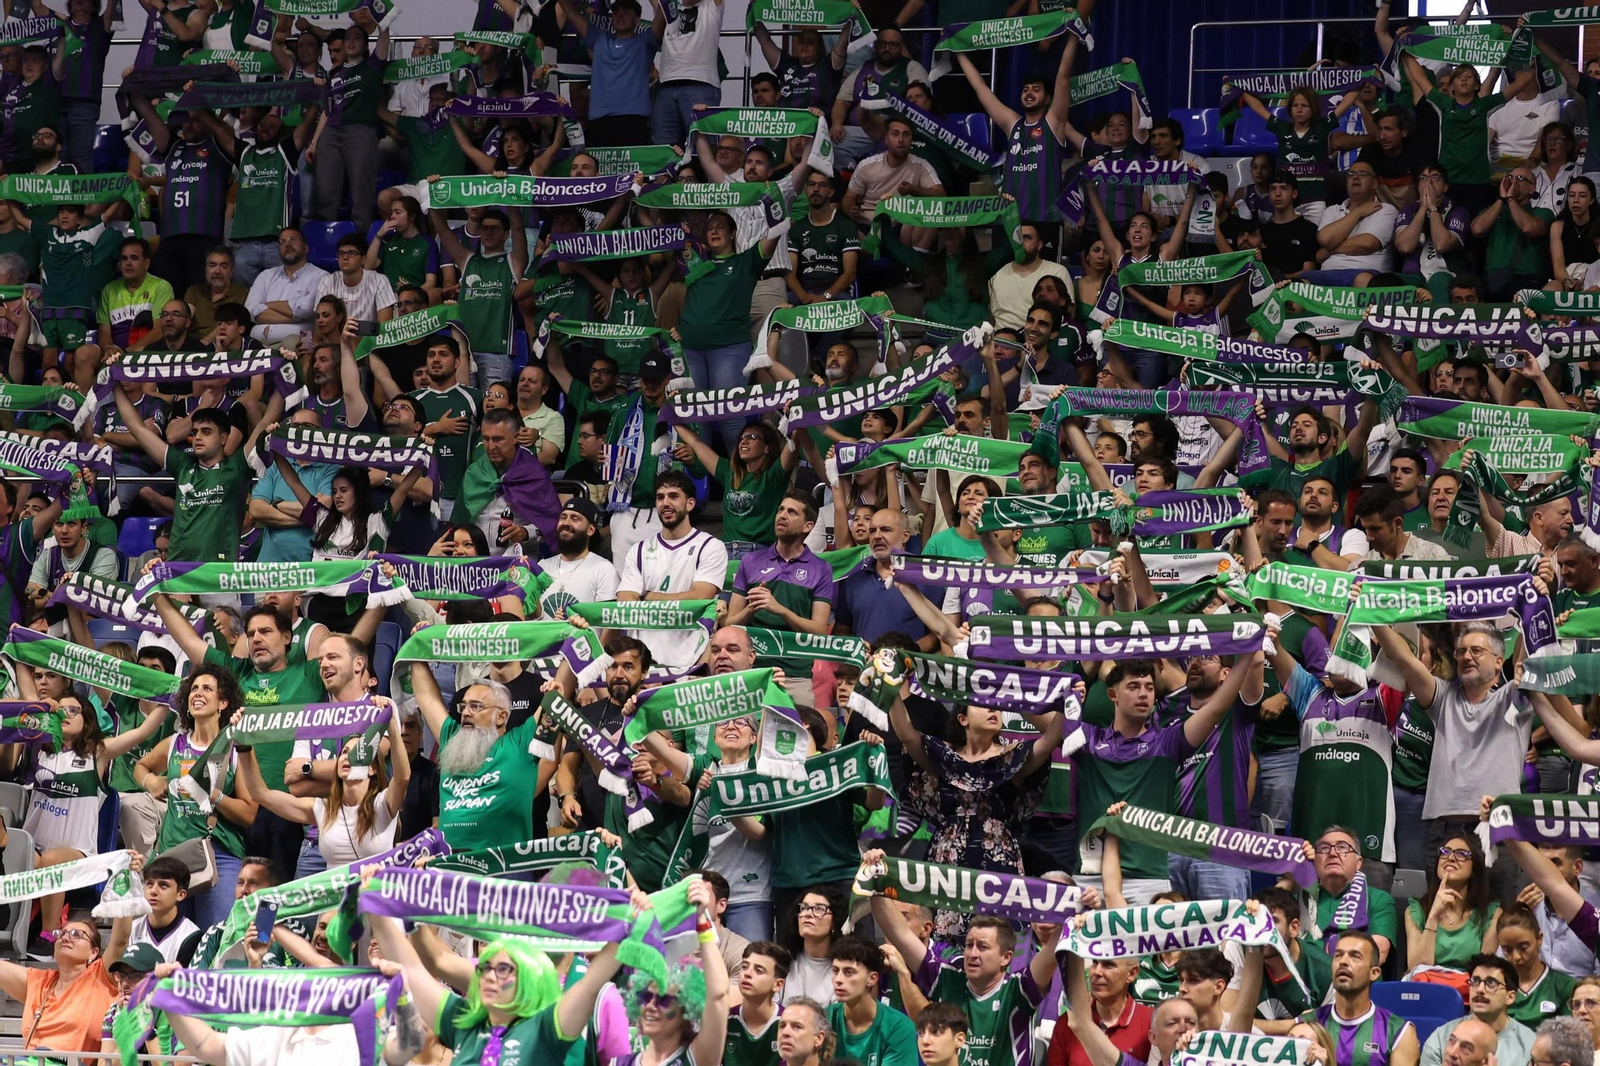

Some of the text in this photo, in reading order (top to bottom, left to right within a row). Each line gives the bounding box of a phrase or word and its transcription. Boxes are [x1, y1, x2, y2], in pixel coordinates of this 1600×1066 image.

[280, 1, 339, 13] BALONCESTO
[773, 0, 815, 10] UNICAJA
[762, 8, 824, 23] BALONCESTO
[0, 18, 57, 42] BALONCESTO
[982, 19, 1023, 33] UNICAJA
[1435, 24, 1480, 35] UNICAJA
[464, 31, 522, 45] BALONCESTO
[972, 29, 1033, 46] BALONCESTO
[1456, 38, 1504, 51] UNICAJA
[211, 50, 254, 61] UNICAJA
[406, 55, 442, 66] UNICAJA
[398, 61, 451, 78] BALONCESTO
[1078, 66, 1113, 84] UNICAJA
[1233, 70, 1361, 94] UNICAJA BALONCESTO
[739, 110, 786, 121] UNICAJA
[727, 121, 795, 134] BALONCESTO
[907, 105, 989, 165] TIENE UN PLAN!
[590, 151, 630, 161] UNICAJA
[171, 174, 199, 183] málaga
[256, 168, 278, 176] Unicaja
[16, 177, 70, 193] UNICAJA
[461, 179, 607, 197] Unicaja Baloncesto
[684, 183, 730, 192] UNICAJA
[174, 191, 189, 207] 51
[673, 192, 740, 206] BALONCESTO
[885, 197, 944, 215] UNICAJA
[556, 224, 684, 256] UNICAJA BALONCESTO
[815, 253, 838, 262] Unicaja
[1145, 267, 1217, 281] BALONCESTO
[480, 280, 502, 289] Unicaja
[1290, 283, 1355, 307] UNICAJA
[623, 310, 635, 325] 11
[808, 300, 859, 318] UNICAJA
[1332, 306, 1344, 314] COPA
[384, 310, 428, 330] UNICAJA
[1368, 305, 1521, 335] UNICAJA
[376, 314, 440, 345] BALONCESTO
[1315, 326, 1340, 335] Unicaja
[1133, 321, 1304, 365] Unicaja Baloncesto
[123, 349, 271, 378] UNICAJA
[1218, 364, 1243, 380] Unicaja
[1264, 363, 1335, 376] Unicaja
[818, 345, 952, 421] UNICAJA
[675, 379, 800, 419] UNICAJA
[1068, 388, 1255, 422] BALONCESTO MALAGA
[1472, 408, 1530, 425] UNICAJA
[1458, 421, 1542, 437] BALONCESTO
[286, 427, 433, 469] UNICAJA
[922, 436, 979, 457] UNICAJA
[1179, 437, 1209, 447] Unicaja
[1490, 437, 1552, 452] UNICAJA
[908, 449, 989, 473] BALONCESTO
[1486, 453, 1564, 469] ALONCESTO
[194, 484, 224, 498] Unicaja
[1162, 494, 1233, 523] UNICAJA
[220, 569, 316, 590] BALONCESTO
[434, 565, 500, 595] BALONCESTO
[1148, 568, 1179, 579] Unicaja
[1256, 564, 1329, 594] Unicaja
[660, 576, 670, 592] 4
[1355, 588, 1414, 613] nicaja
[601, 607, 694, 629] BALONCESTO
[446, 625, 508, 638] UNICAJA
[1012, 618, 1212, 651] UNICAJA
[432, 638, 520, 656] BALONCESTO
[65, 644, 121, 671] UNICAJA
[48, 654, 131, 692] BALONCESTO
[674, 677, 748, 707] UNICAJA
[662, 689, 764, 727] BALONCESTO
[285, 705, 384, 734] BALONCESTO
[551, 696, 618, 765] UNICAJA
[1336, 729, 1369, 741] Unicaja
[1402, 722, 1432, 742] Unicaja
[1315, 748, 1360, 762] málaga
[51, 780, 79, 794] Unicaja
[442, 771, 501, 789] UNIONES
[717, 755, 858, 806] Unicaja
[34, 800, 68, 817] málaga
[444, 795, 496, 812] SUMAN
[515, 830, 601, 856] Unicaja
[1122, 805, 1305, 864] UNICAJA BALONCESTO
[458, 854, 489, 871] Unicaja
[898, 860, 1082, 914] UNICAJA
[380, 870, 610, 926] UNICAJA BALONCESTO
[1081, 899, 1255, 939] UNICAJA
[174, 972, 302, 1020] BALONCESTO
